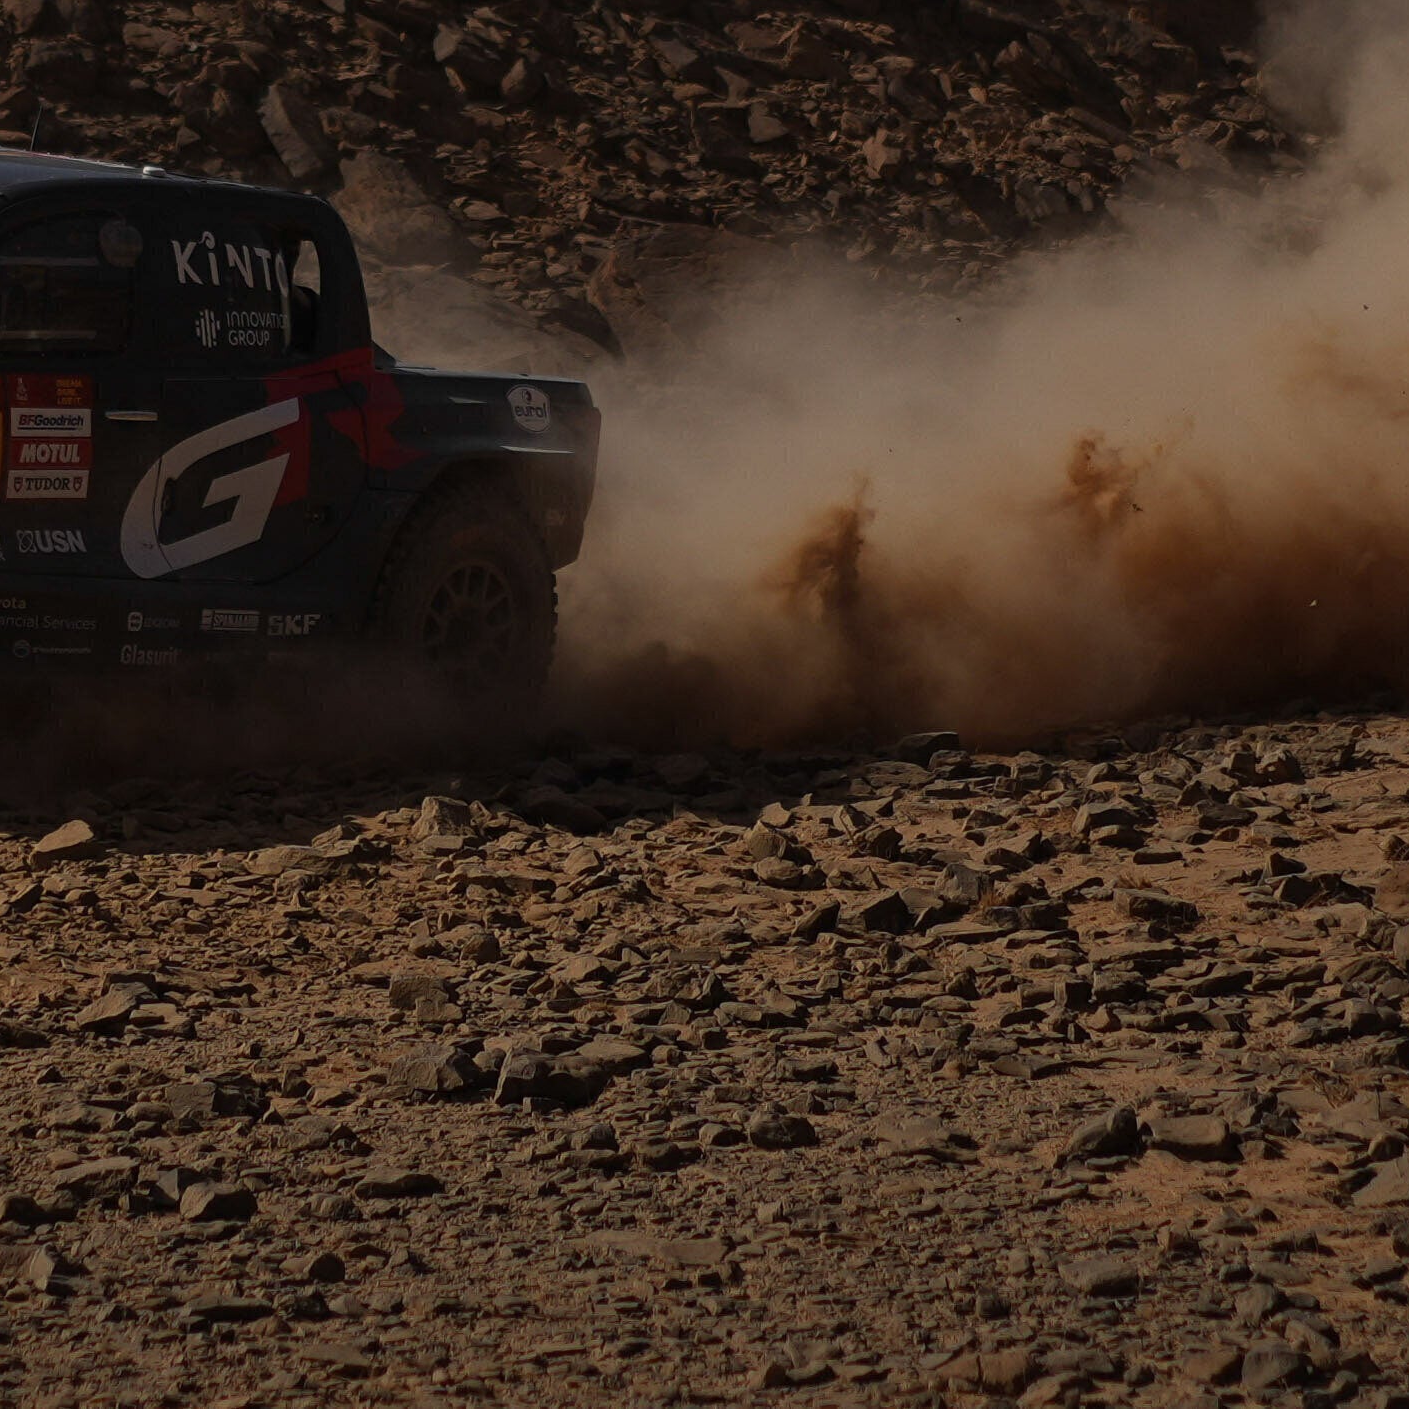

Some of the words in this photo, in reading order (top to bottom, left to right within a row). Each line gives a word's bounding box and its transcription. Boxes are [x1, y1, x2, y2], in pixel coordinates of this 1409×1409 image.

[228, 330, 271, 347] GROUP
[515, 402, 548, 419] eurol
[18, 414, 84, 427] BFGoodrich
[19, 443, 81, 464] MOTUL
[25, 477, 71, 491] TUDOR
[32, 529, 87, 554] USN
[42, 614, 97, 631] Services
[266, 614, 321, 636] SKF
[120, 643, 180, 666] Glasurit
